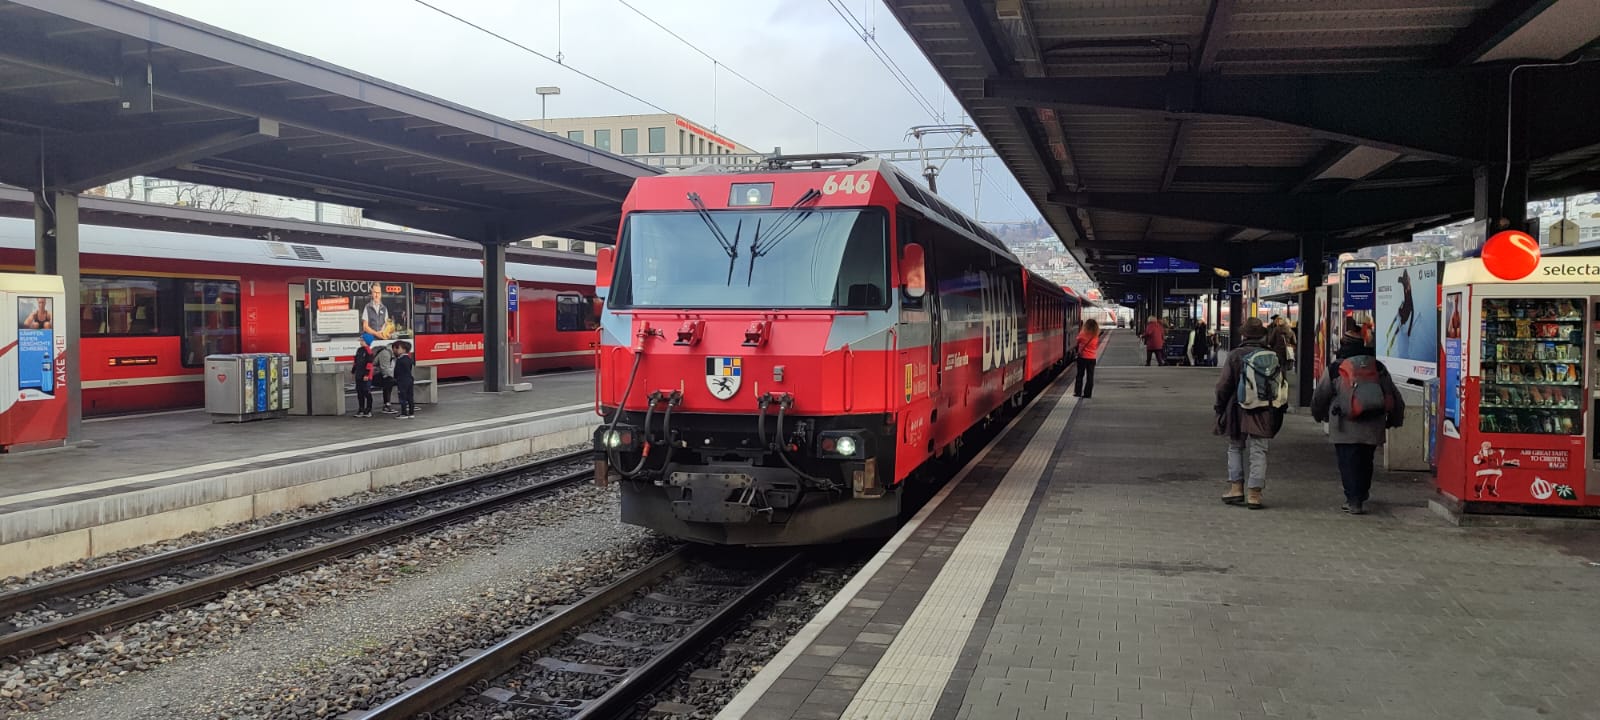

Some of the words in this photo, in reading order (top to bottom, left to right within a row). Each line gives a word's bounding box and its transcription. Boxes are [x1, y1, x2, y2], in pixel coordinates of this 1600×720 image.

[823, 173, 871, 195] 646
[1463, 235, 1479, 250] Chur
[1121, 264, 1132, 273] 10
[1543, 264, 1600, 276] selecta
[316, 280, 374, 293] STEINBOCK
[1232, 283, 1241, 293] C
[56, 335, 65, 358] ME!
[56, 359, 66, 388] TAKE
